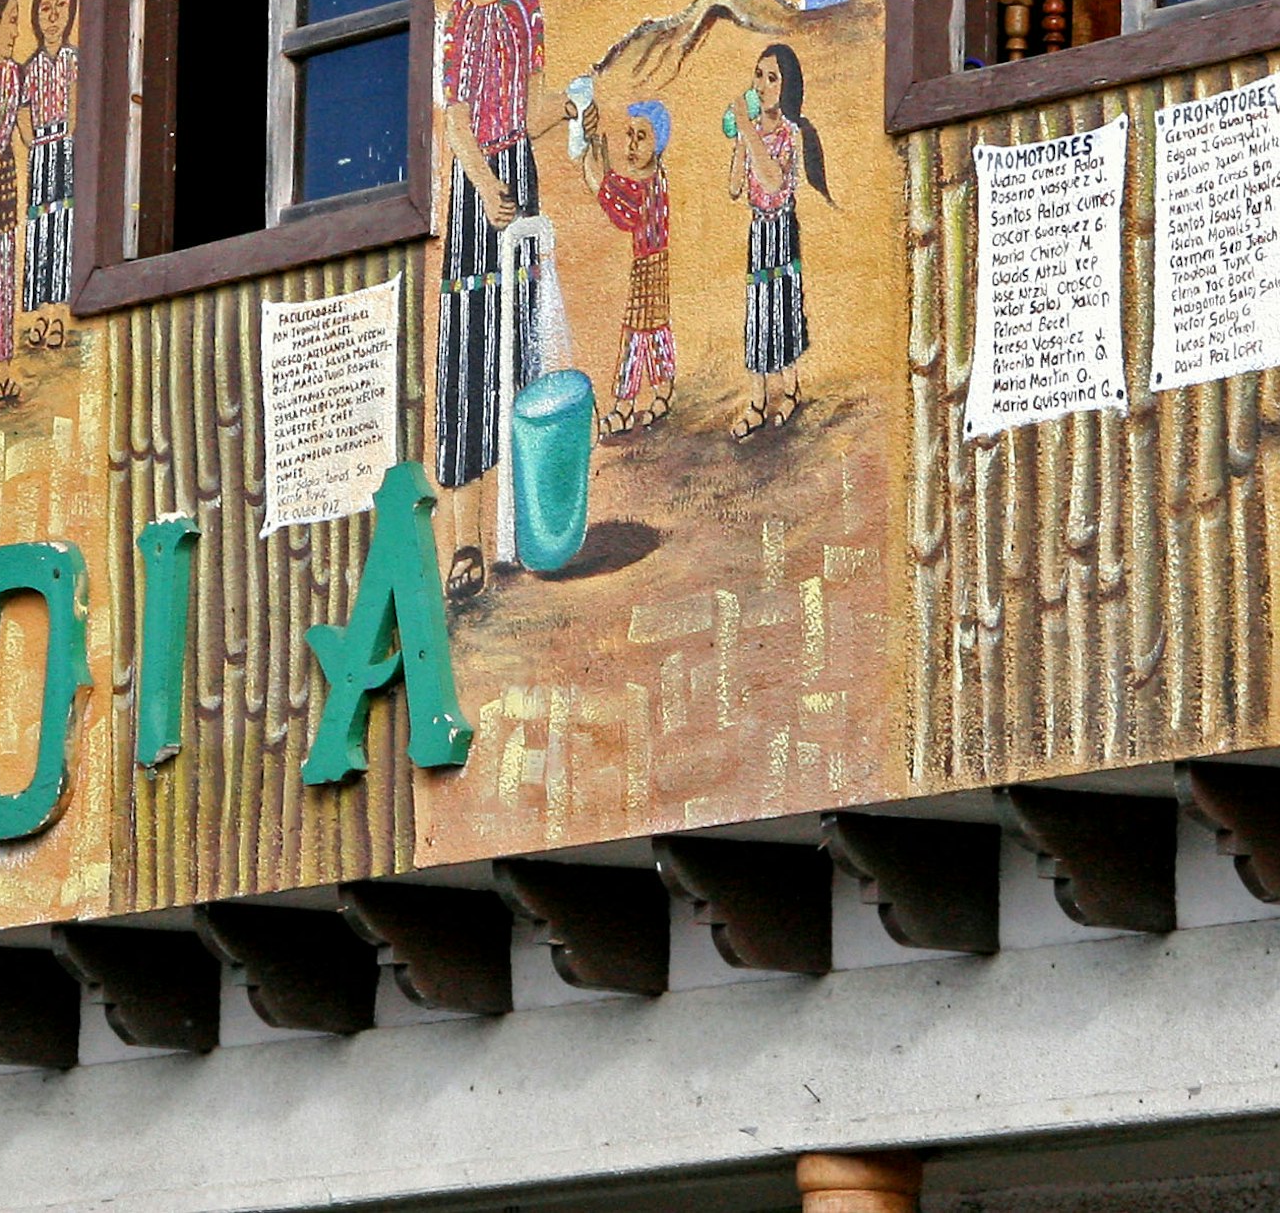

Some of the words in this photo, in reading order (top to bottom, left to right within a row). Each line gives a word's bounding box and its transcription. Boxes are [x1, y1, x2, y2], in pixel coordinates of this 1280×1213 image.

[1172, 83, 1277, 127] PROMOTORES
[986, 134, 1094, 173] PROMOTORES
[991, 207, 1031, 227] Santos
